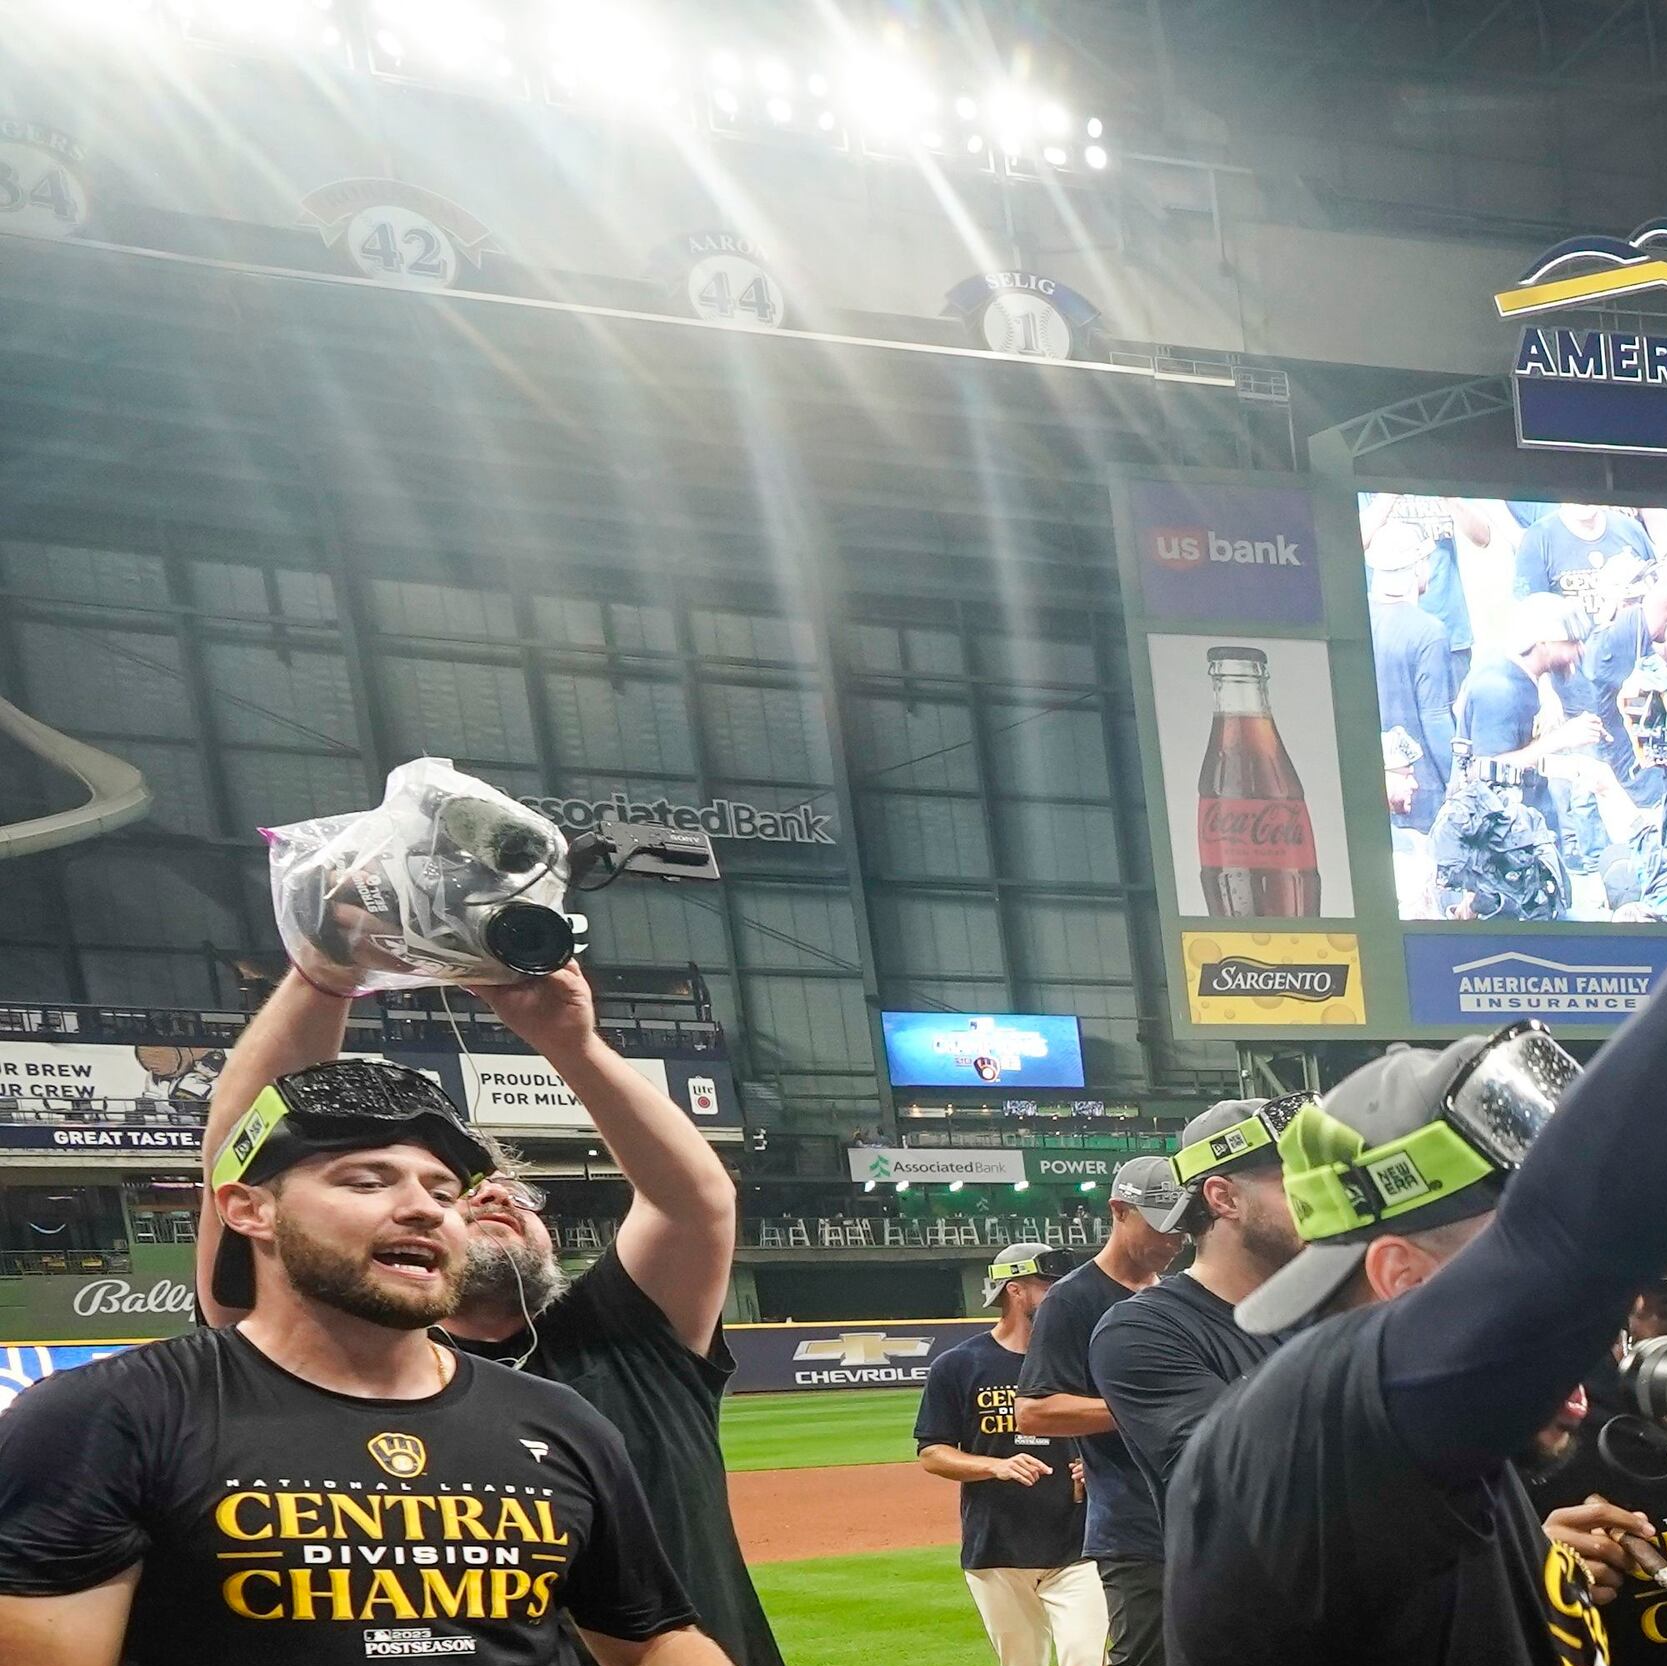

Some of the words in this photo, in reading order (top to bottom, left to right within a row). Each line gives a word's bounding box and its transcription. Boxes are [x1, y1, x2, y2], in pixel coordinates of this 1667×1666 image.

[360, 221, 444, 277] 42
[985, 272, 1056, 296] SELIG
[699, 270, 777, 323] 44
[1010, 311, 1042, 356] 1
[1157, 535, 1199, 561] us
[1207, 530, 1302, 567] bank
[1202, 801, 1306, 846] Coca-Cola
[1213, 965, 1331, 992] SARGENTO
[1460, 976, 1568, 993] AMERICAN
[1576, 978, 1649, 994] FAMILY
[1476, 996, 1637, 1009] INSURANCE
[26, 1063, 92, 1078] BREW
[31, 1084, 95, 1099] CREW
[492, 1091, 530, 1105] FOR
[693, 1085, 715, 1096] Lite
[54, 1131, 122, 1145] GREAT
[126, 1131, 201, 1146] TASTE.
[1040, 1160, 1094, 1175] POWER
[1377, 1163, 1409, 1183] NEW
[1386, 1174, 1420, 1196] ERA
[226, 1478, 411, 1491] NATIONAL
[440, 1481, 555, 1497] LEAGUE
[215, 1491, 569, 1546] CENTRAL
[303, 1544, 521, 1566] DIVISION
[222, 1567, 559, 1622] CHAMPS
[391, 1629, 432, 1640] 2023
[364, 1638, 477, 1656] POSTSEASON
